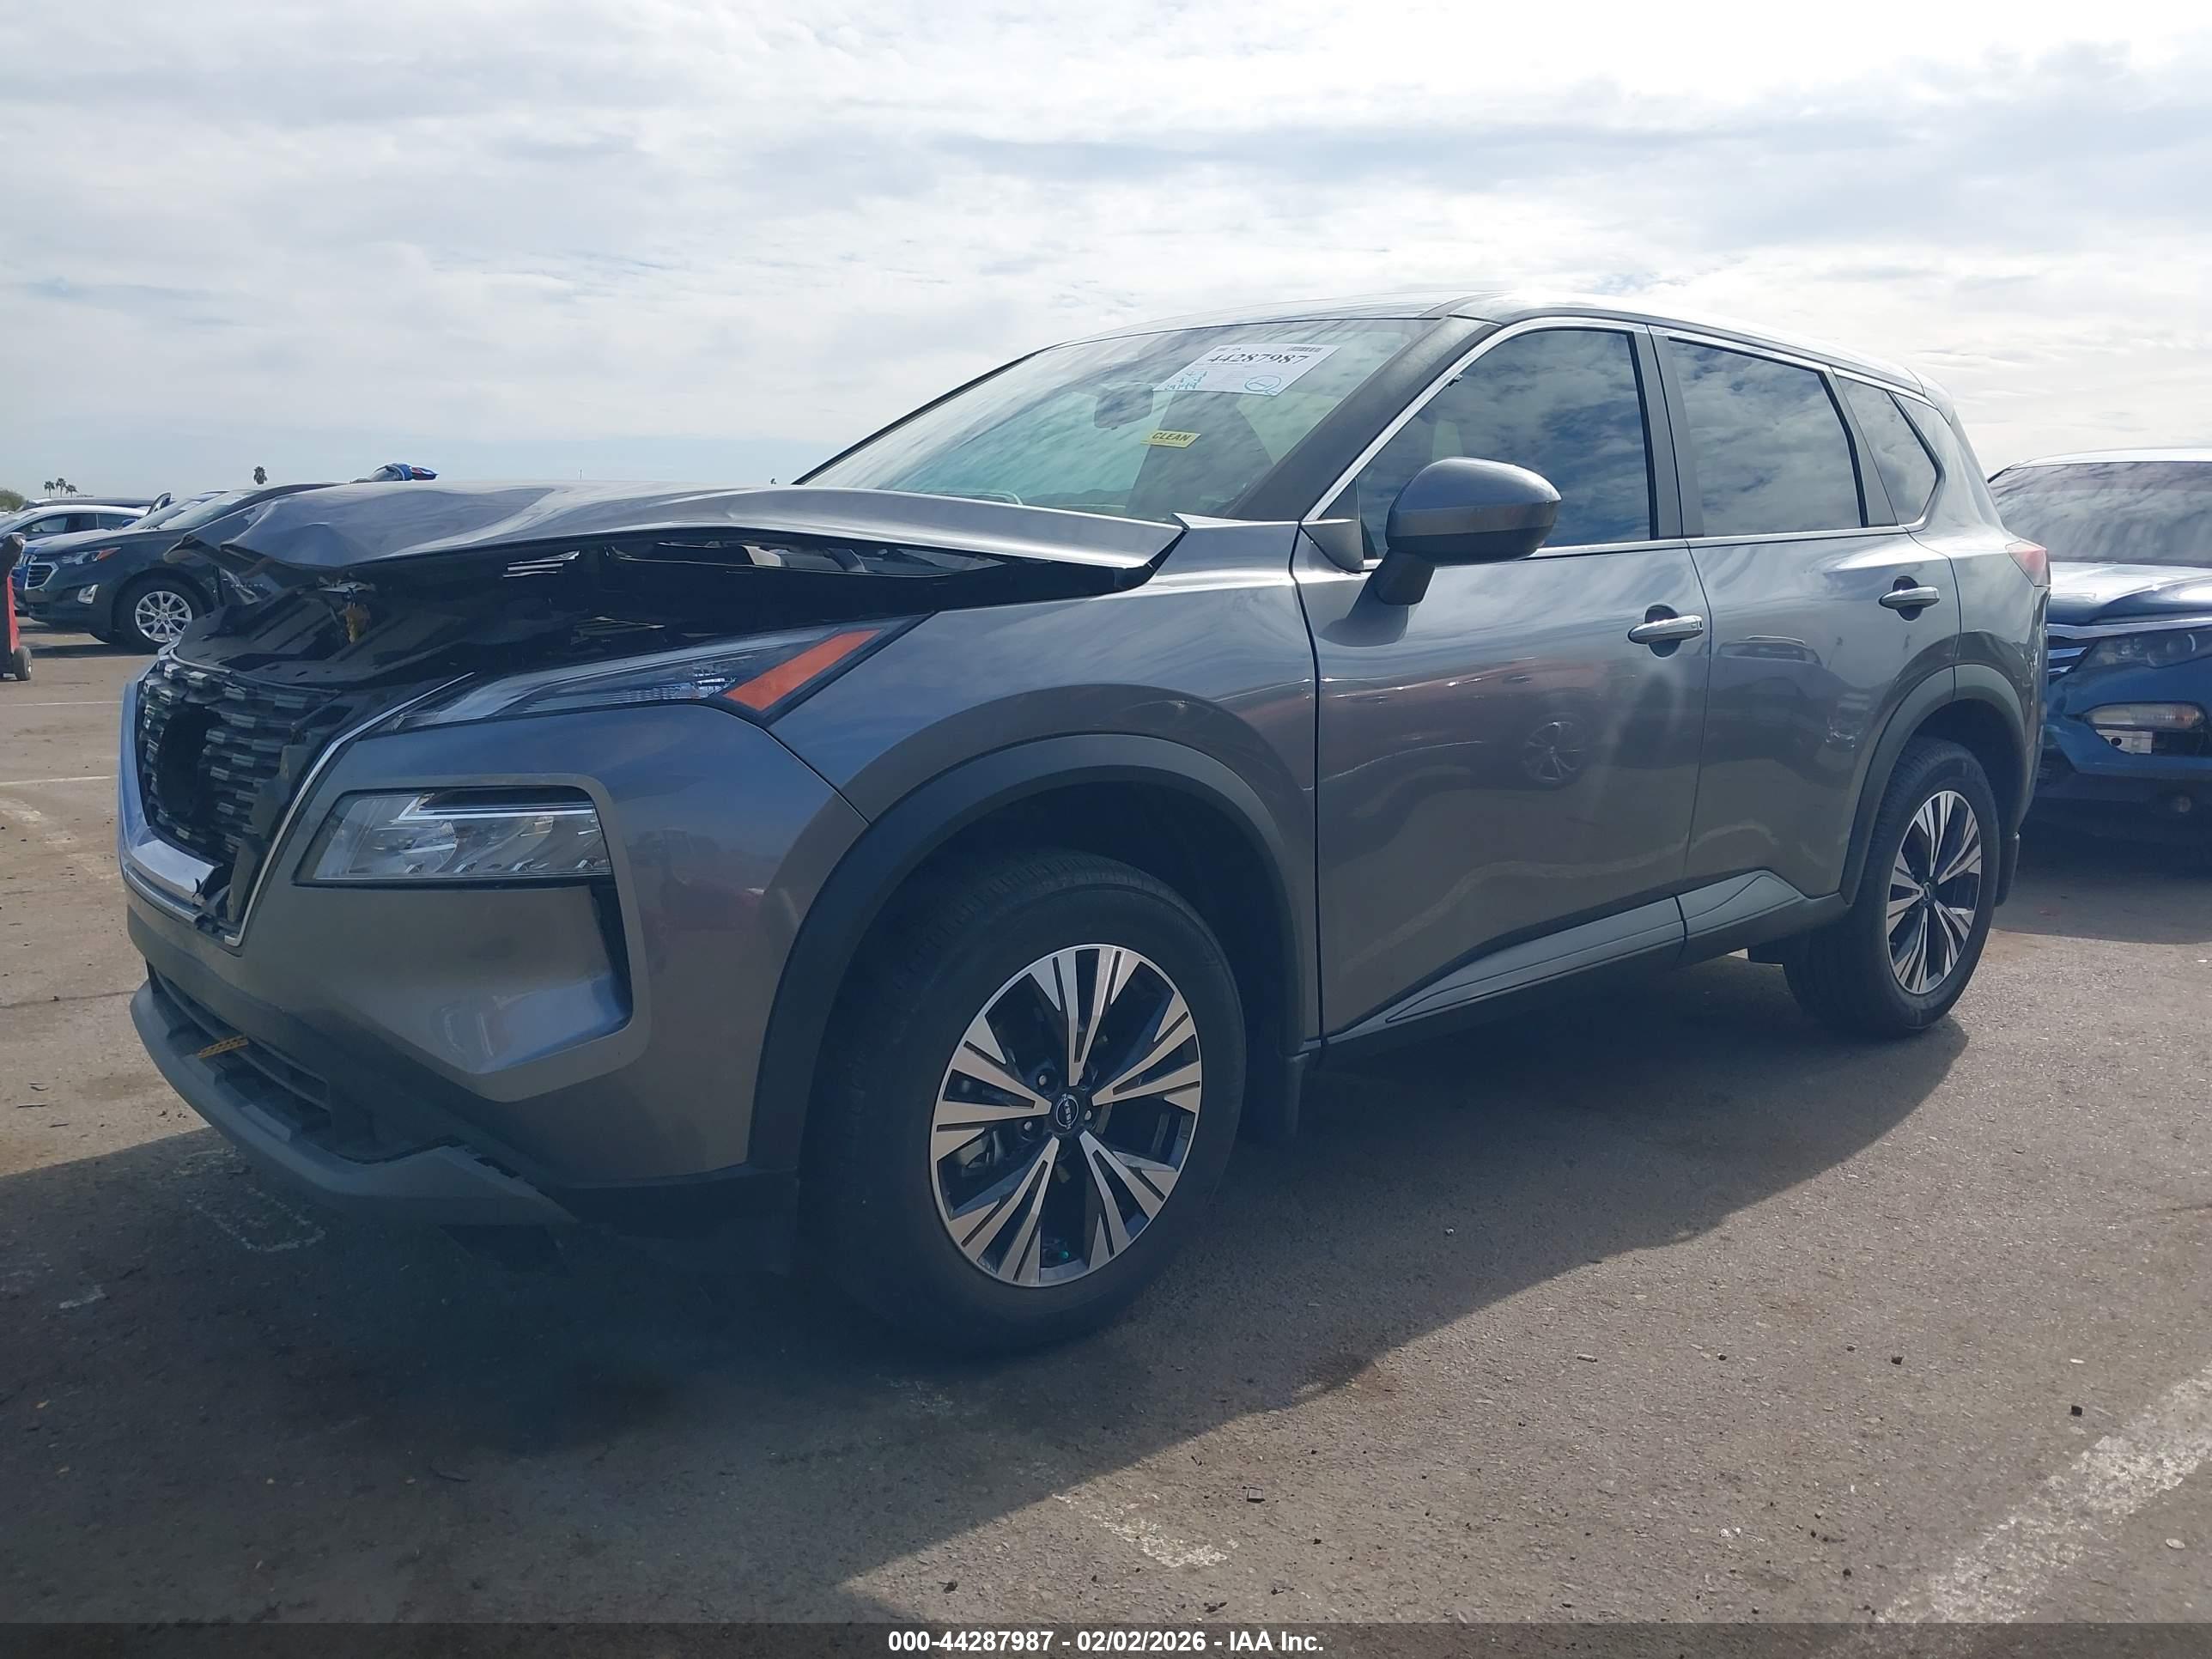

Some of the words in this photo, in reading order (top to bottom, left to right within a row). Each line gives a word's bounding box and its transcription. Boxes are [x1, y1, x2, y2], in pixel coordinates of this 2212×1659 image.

[1207, 353, 1310, 365] 44287987
[1152, 432, 1192, 441] CLEAN
[1061, 1093, 1072, 1130] NISSAN
